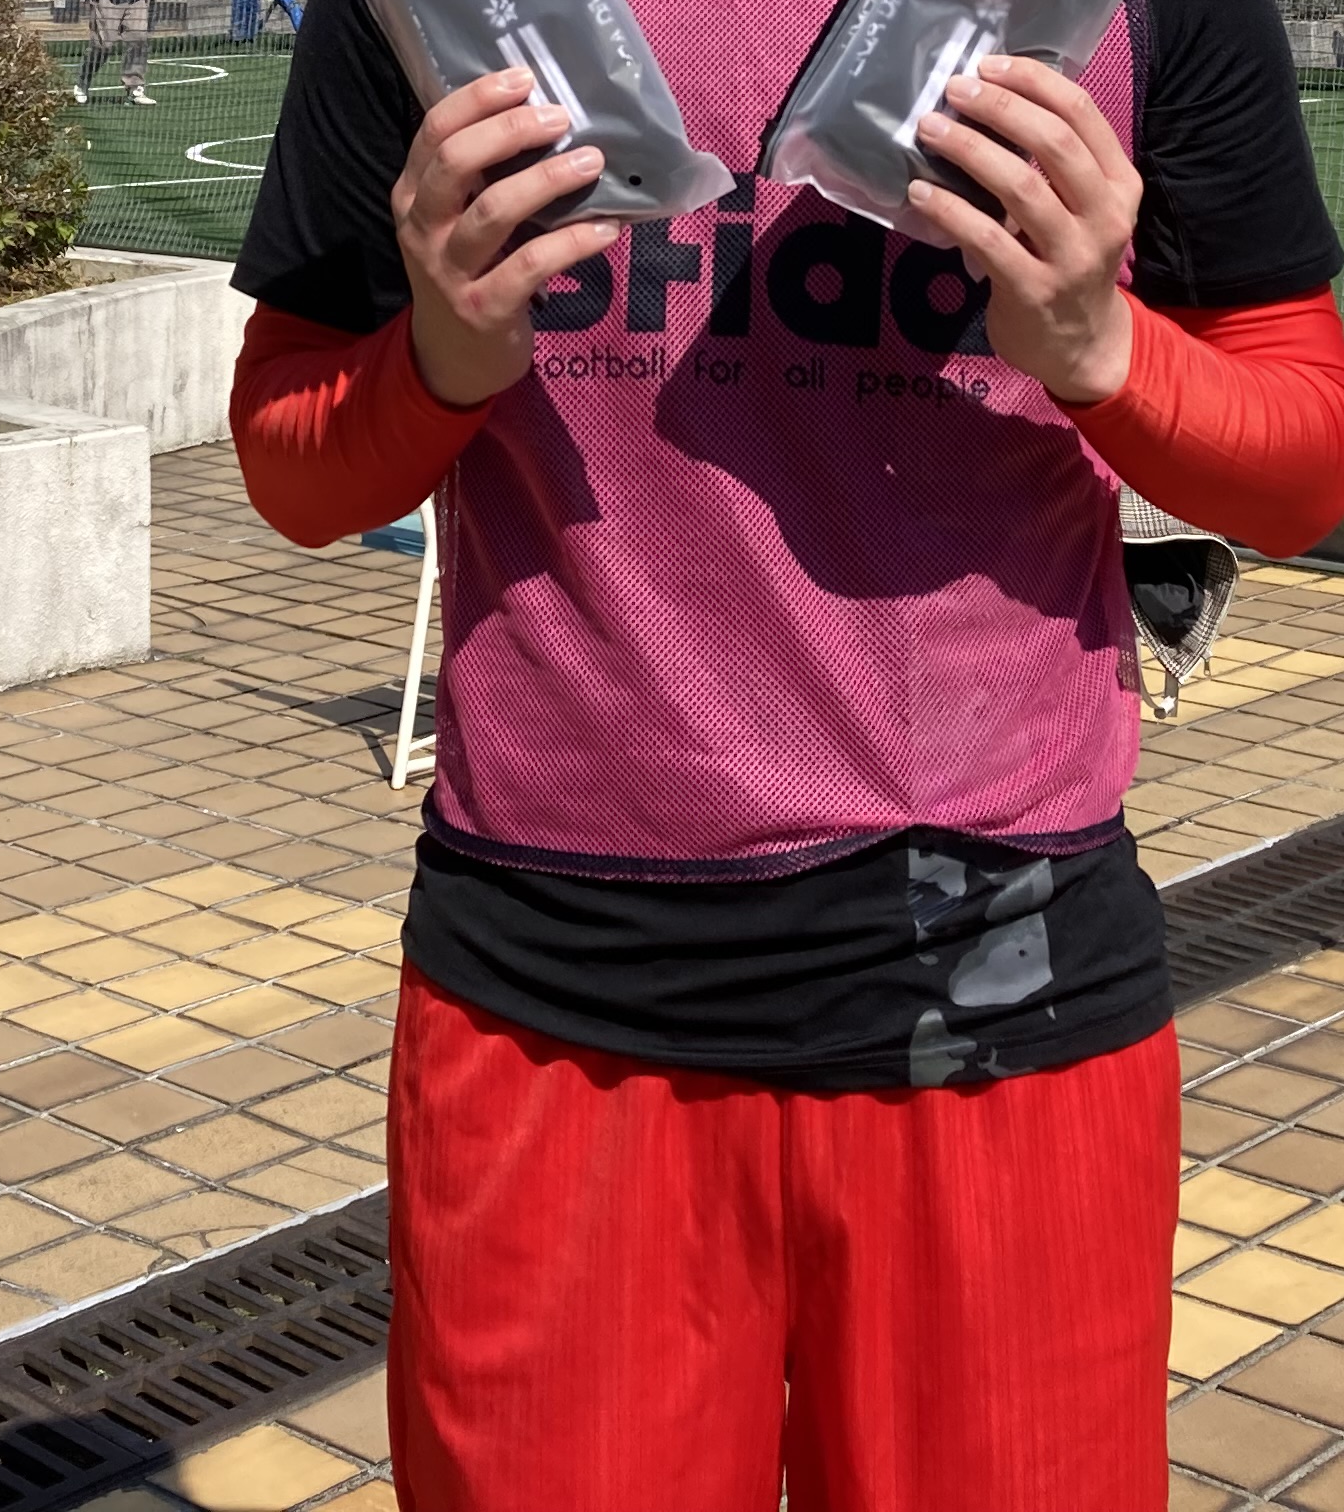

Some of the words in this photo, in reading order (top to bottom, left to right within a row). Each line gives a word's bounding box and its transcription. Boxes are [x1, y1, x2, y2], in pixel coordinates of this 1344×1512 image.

[694, 350, 744, 384] for
[784, 356, 825, 390] all
[856, 367, 990, 408] people
